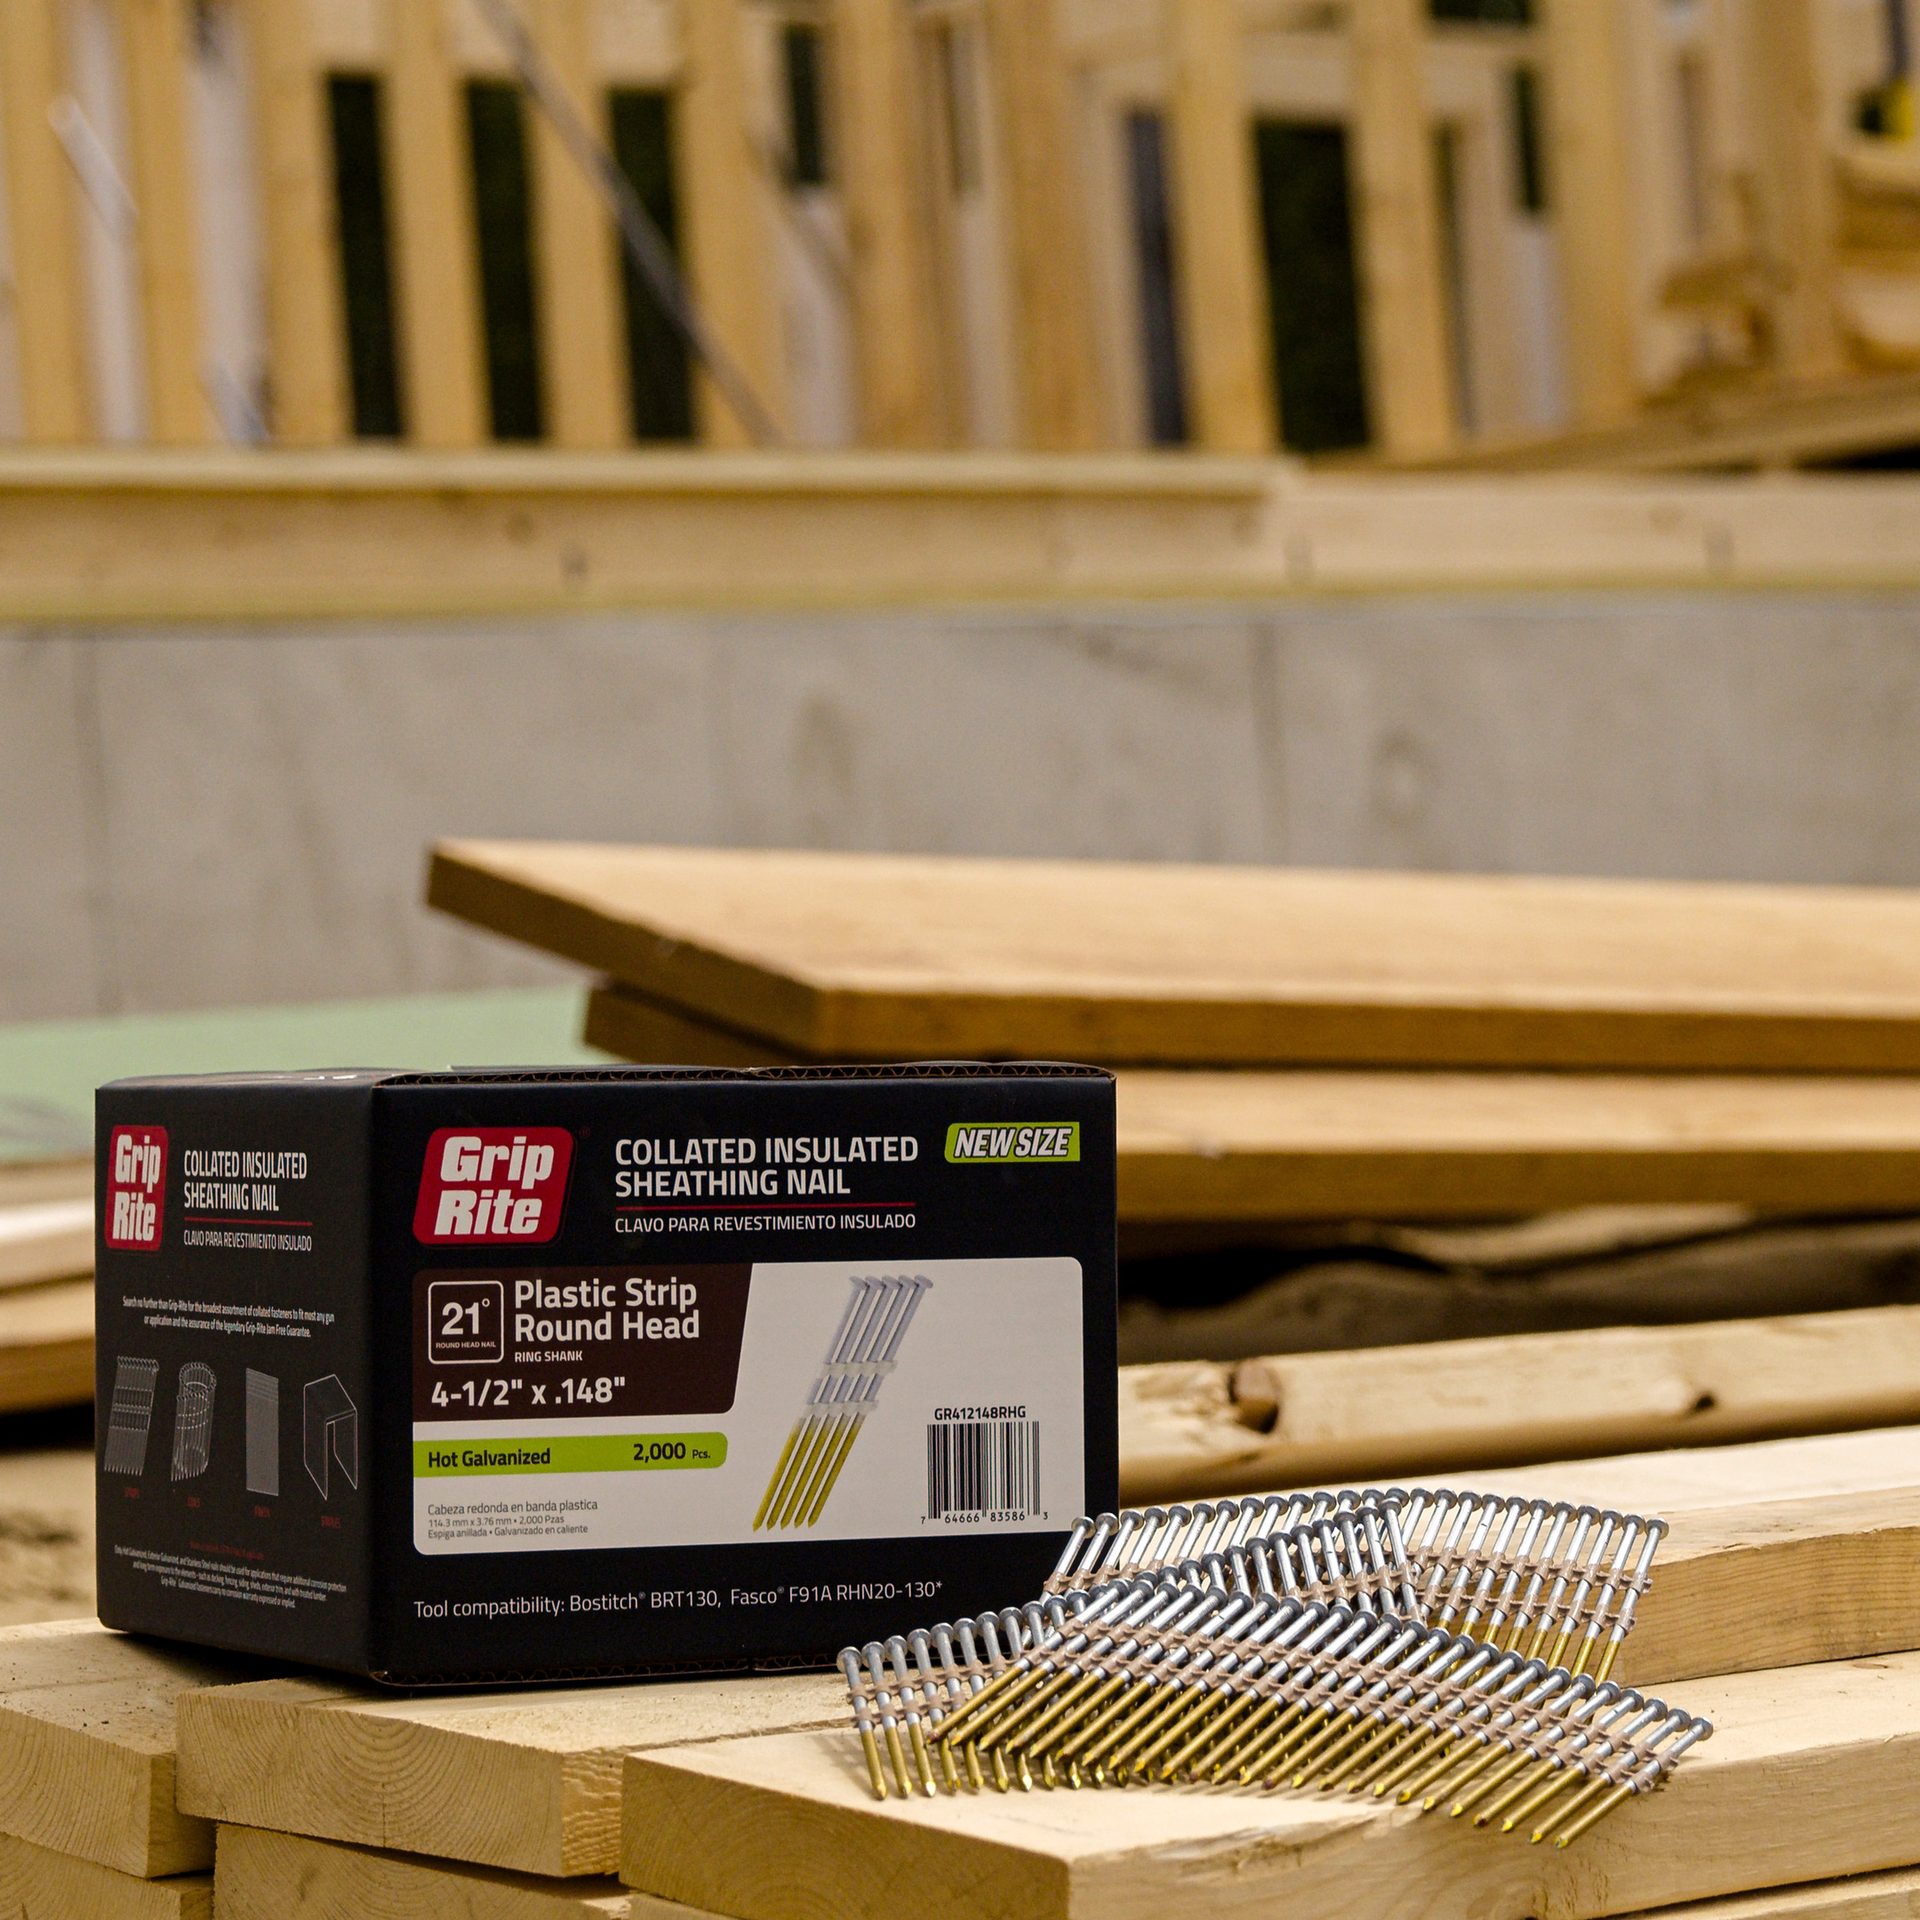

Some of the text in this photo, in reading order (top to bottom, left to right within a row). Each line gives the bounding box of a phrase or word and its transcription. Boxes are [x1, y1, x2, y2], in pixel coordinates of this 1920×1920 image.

[615, 1136, 918, 1166] COLLATED INSULATED
[954, 1126, 1072, 1158] NEW SIZE
[115, 1134, 161, 1193] Grip
[184, 1150, 307, 1180] COLLATED INSULATED
[440, 1136, 555, 1190] Grip
[184, 1182, 280, 1212] SHEATHING NAIL
[615, 1168, 851, 1197] SHEATHING NAIL
[112, 1191, 156, 1241] Rite
[433, 1189, 543, 1235] Rite
[615, 1213, 916, 1233] CLAVO PARA REVESTIMIENTO INSULADO
[184, 1229, 312, 1252] CLAVO PARA REVESTIMIENTO INSULADO
[515, 1276, 697, 1313] Plastic Strip
[515, 1309, 700, 1342] Round Head
[460, 1341, 480, 1349] HEAD
[480, 1340, 497, 1349] NAIL
[515, 1350, 583, 1363] RING SHANK
[431, 1376, 626, 1408] 4-1/2" x .148"
[934, 1405, 1027, 1421] GR412148RHG
[428, 1442, 711, 1469] Hot Galvanized 2,000 Pcs.
[427, 1499, 598, 1516] Cabeza redonda en banda plastica
[428, 1517, 451, 1528] 114.3
[451, 1519, 469, 1527] mm
[476, 1516, 494, 1526] 3.76
[495, 1518, 512, 1526] mm
[545, 1514, 565, 1525] Pzas
[920, 1511, 1049, 1525] 7 64666 83586 3
[428, 1524, 588, 1540] Espiga anillada Galvanizado en caliente
[414, 1600, 448, 1618] Tool
[453, 1596, 565, 1620] compatibility:
[651, 1589, 722, 1611] BRT130,
[789, 1585, 833, 1603] F91A
